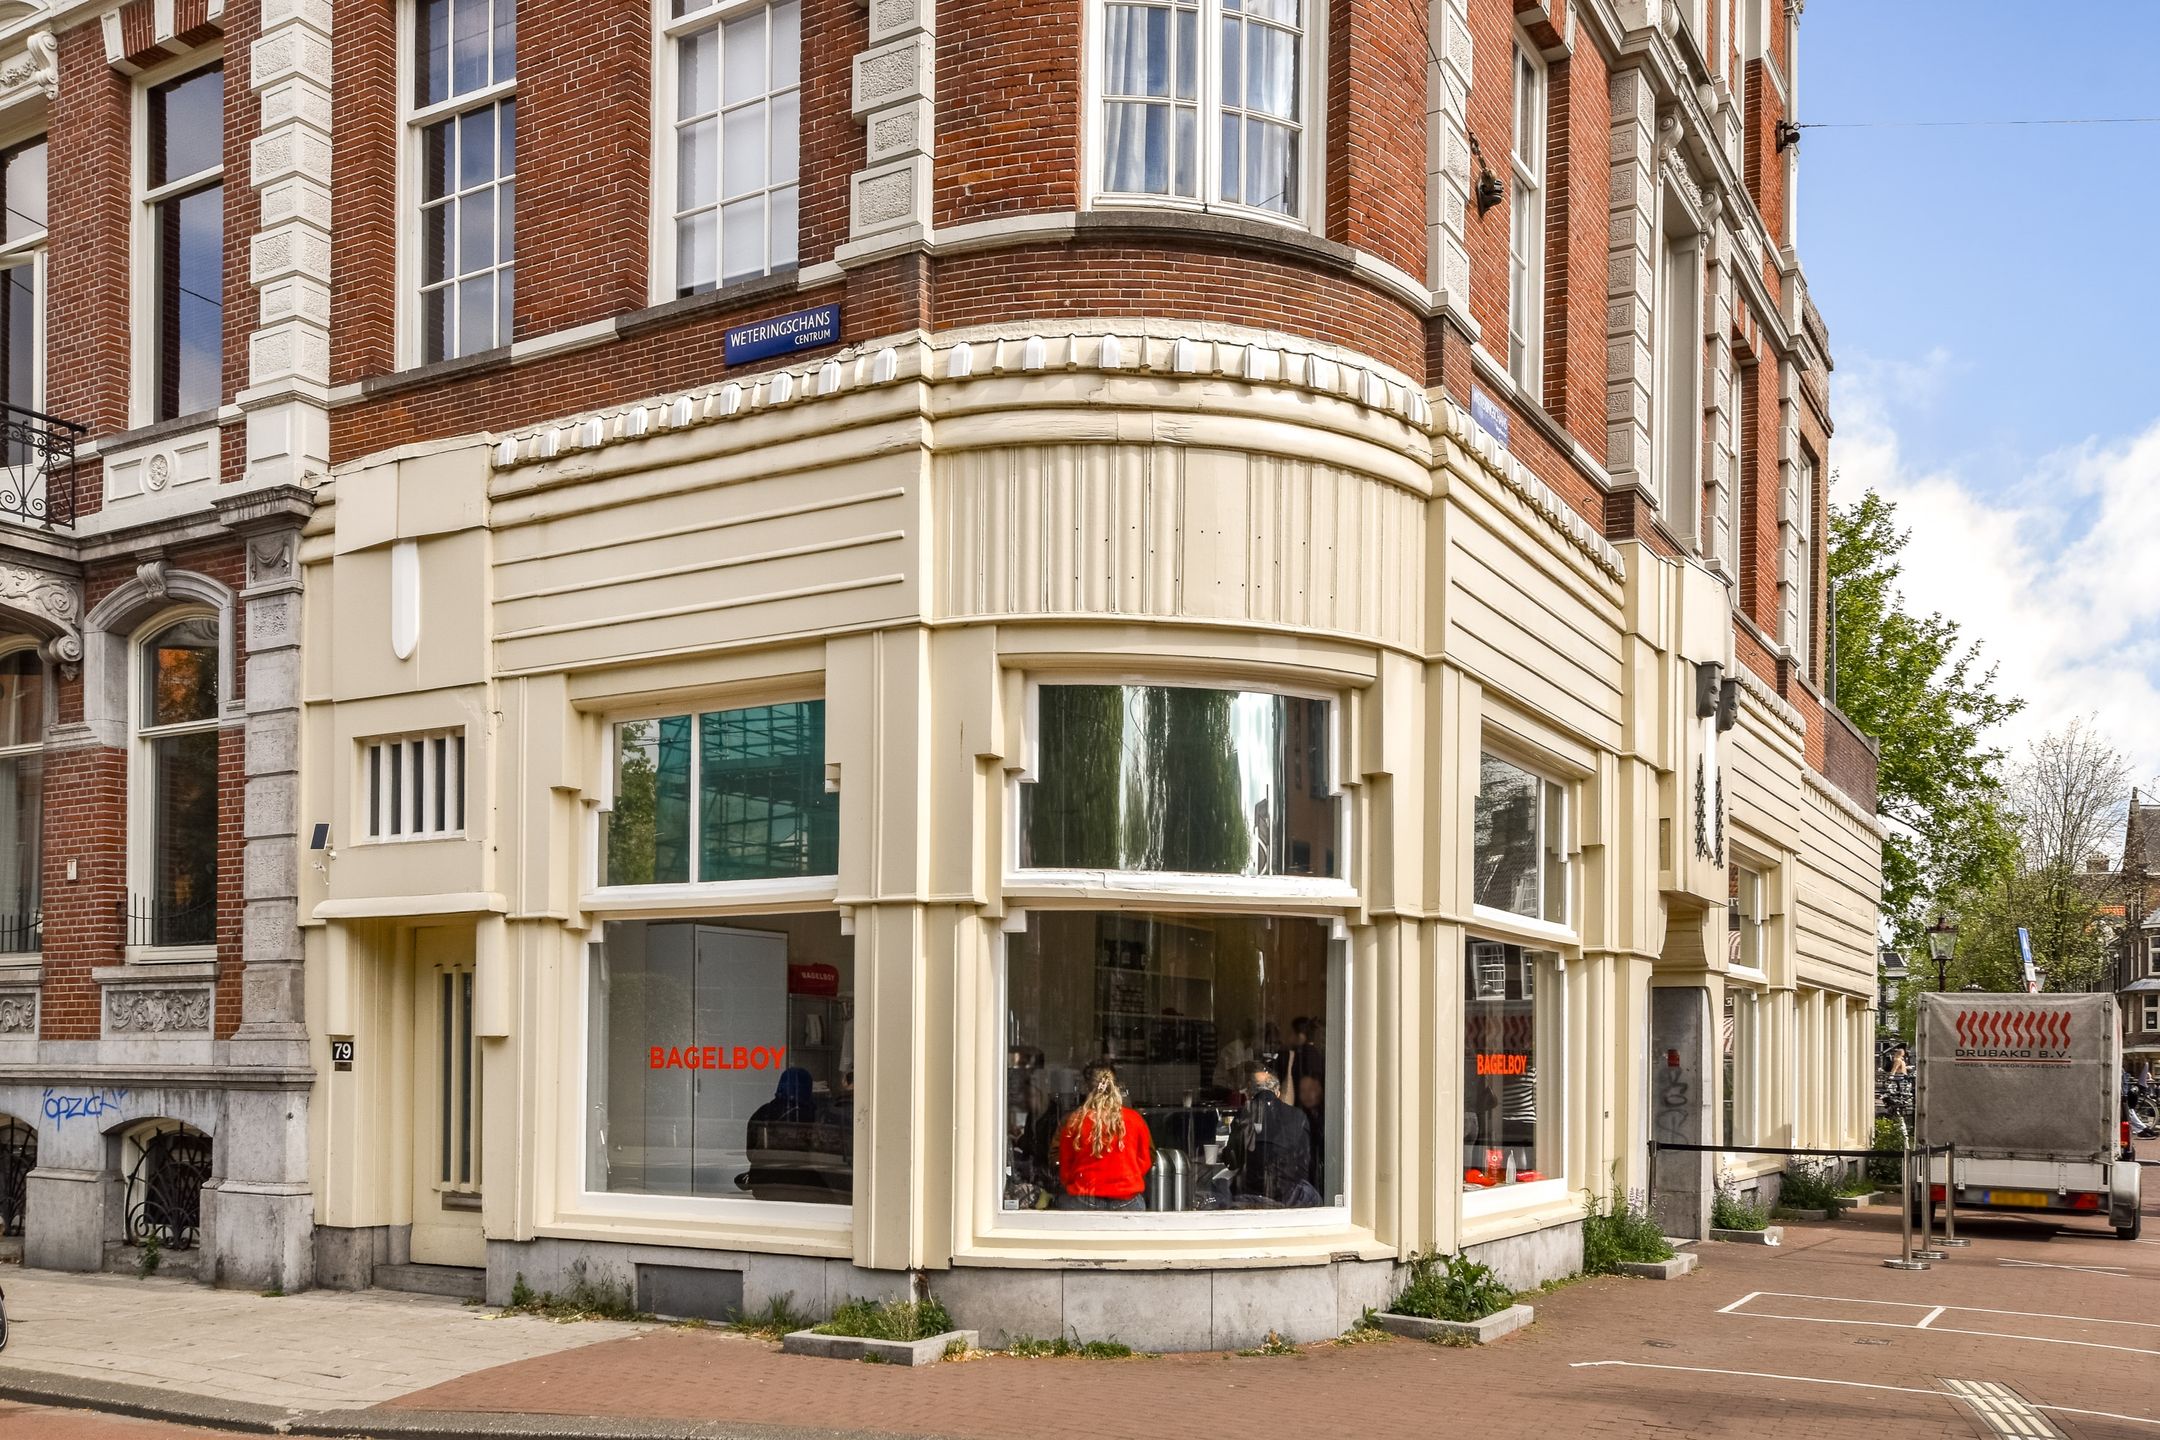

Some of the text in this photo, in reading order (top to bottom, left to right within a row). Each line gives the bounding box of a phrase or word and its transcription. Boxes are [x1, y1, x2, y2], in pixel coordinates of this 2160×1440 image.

[730, 311, 831, 348] WETERINGSCHANS
[794, 328, 831, 345] CENTRUM
[334, 1042, 352, 1059] 79
[649, 1044, 787, 1071] BAGELBOY
[1955, 1049, 2072, 1059] DRUBAKO B.V.
[1476, 1053, 1527, 1075] BAGELBOY
